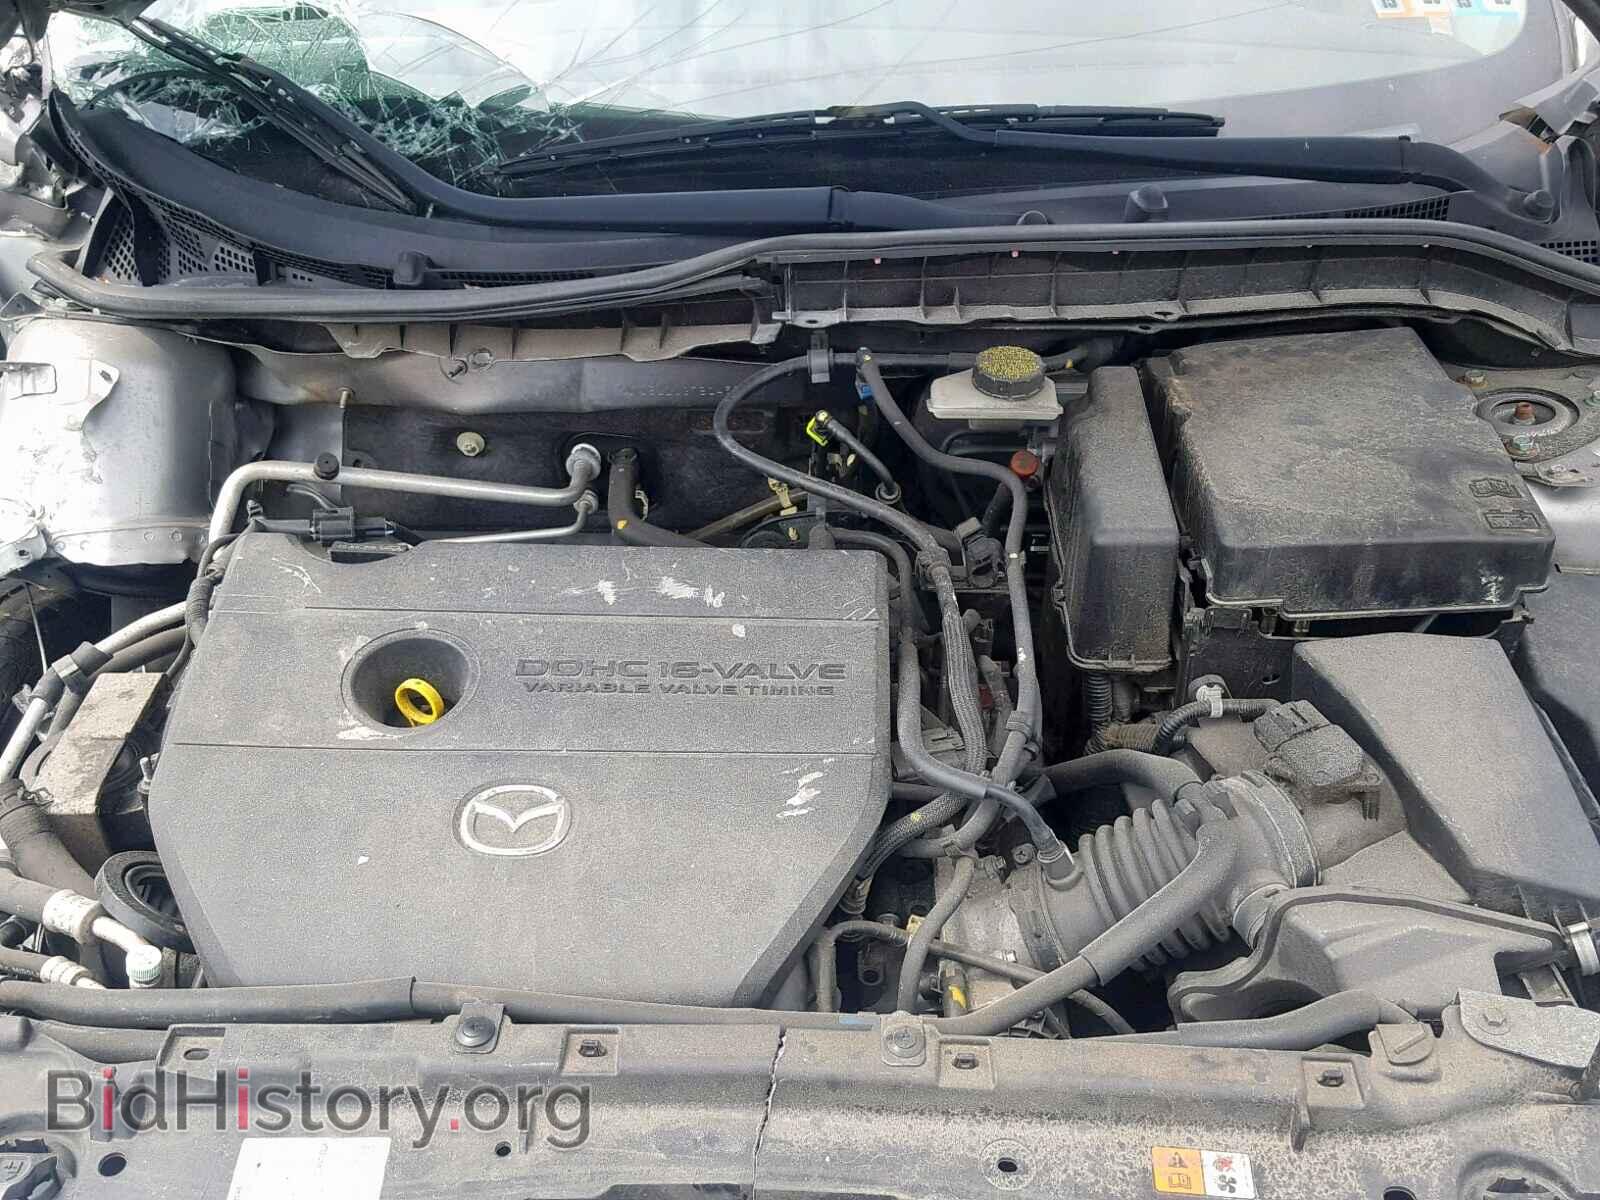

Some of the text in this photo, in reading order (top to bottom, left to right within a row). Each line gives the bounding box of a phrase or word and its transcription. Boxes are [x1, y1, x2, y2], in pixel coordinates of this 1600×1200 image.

[515, 659, 847, 681] DOHC 16-VALVE
[523, 682, 835, 697] VARIABLE VALVE TIMING
